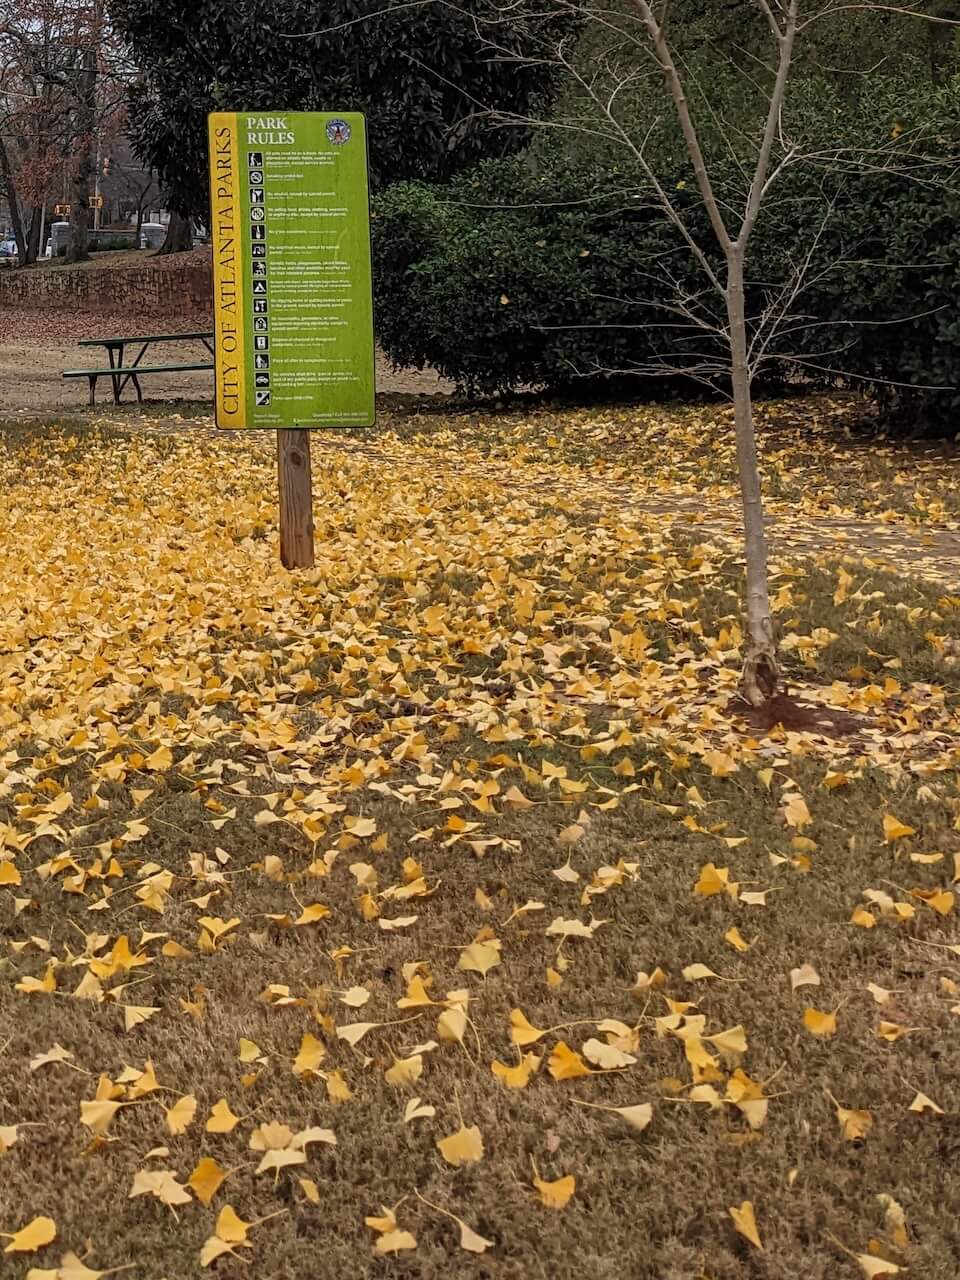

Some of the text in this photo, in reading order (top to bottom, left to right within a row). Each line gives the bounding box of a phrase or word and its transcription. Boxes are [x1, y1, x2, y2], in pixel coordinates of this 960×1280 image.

[247, 117, 288, 130] PARK
[247, 131, 295, 145] RULES
[215, 127, 239, 415] CITY OF ATLANTA PARKS
